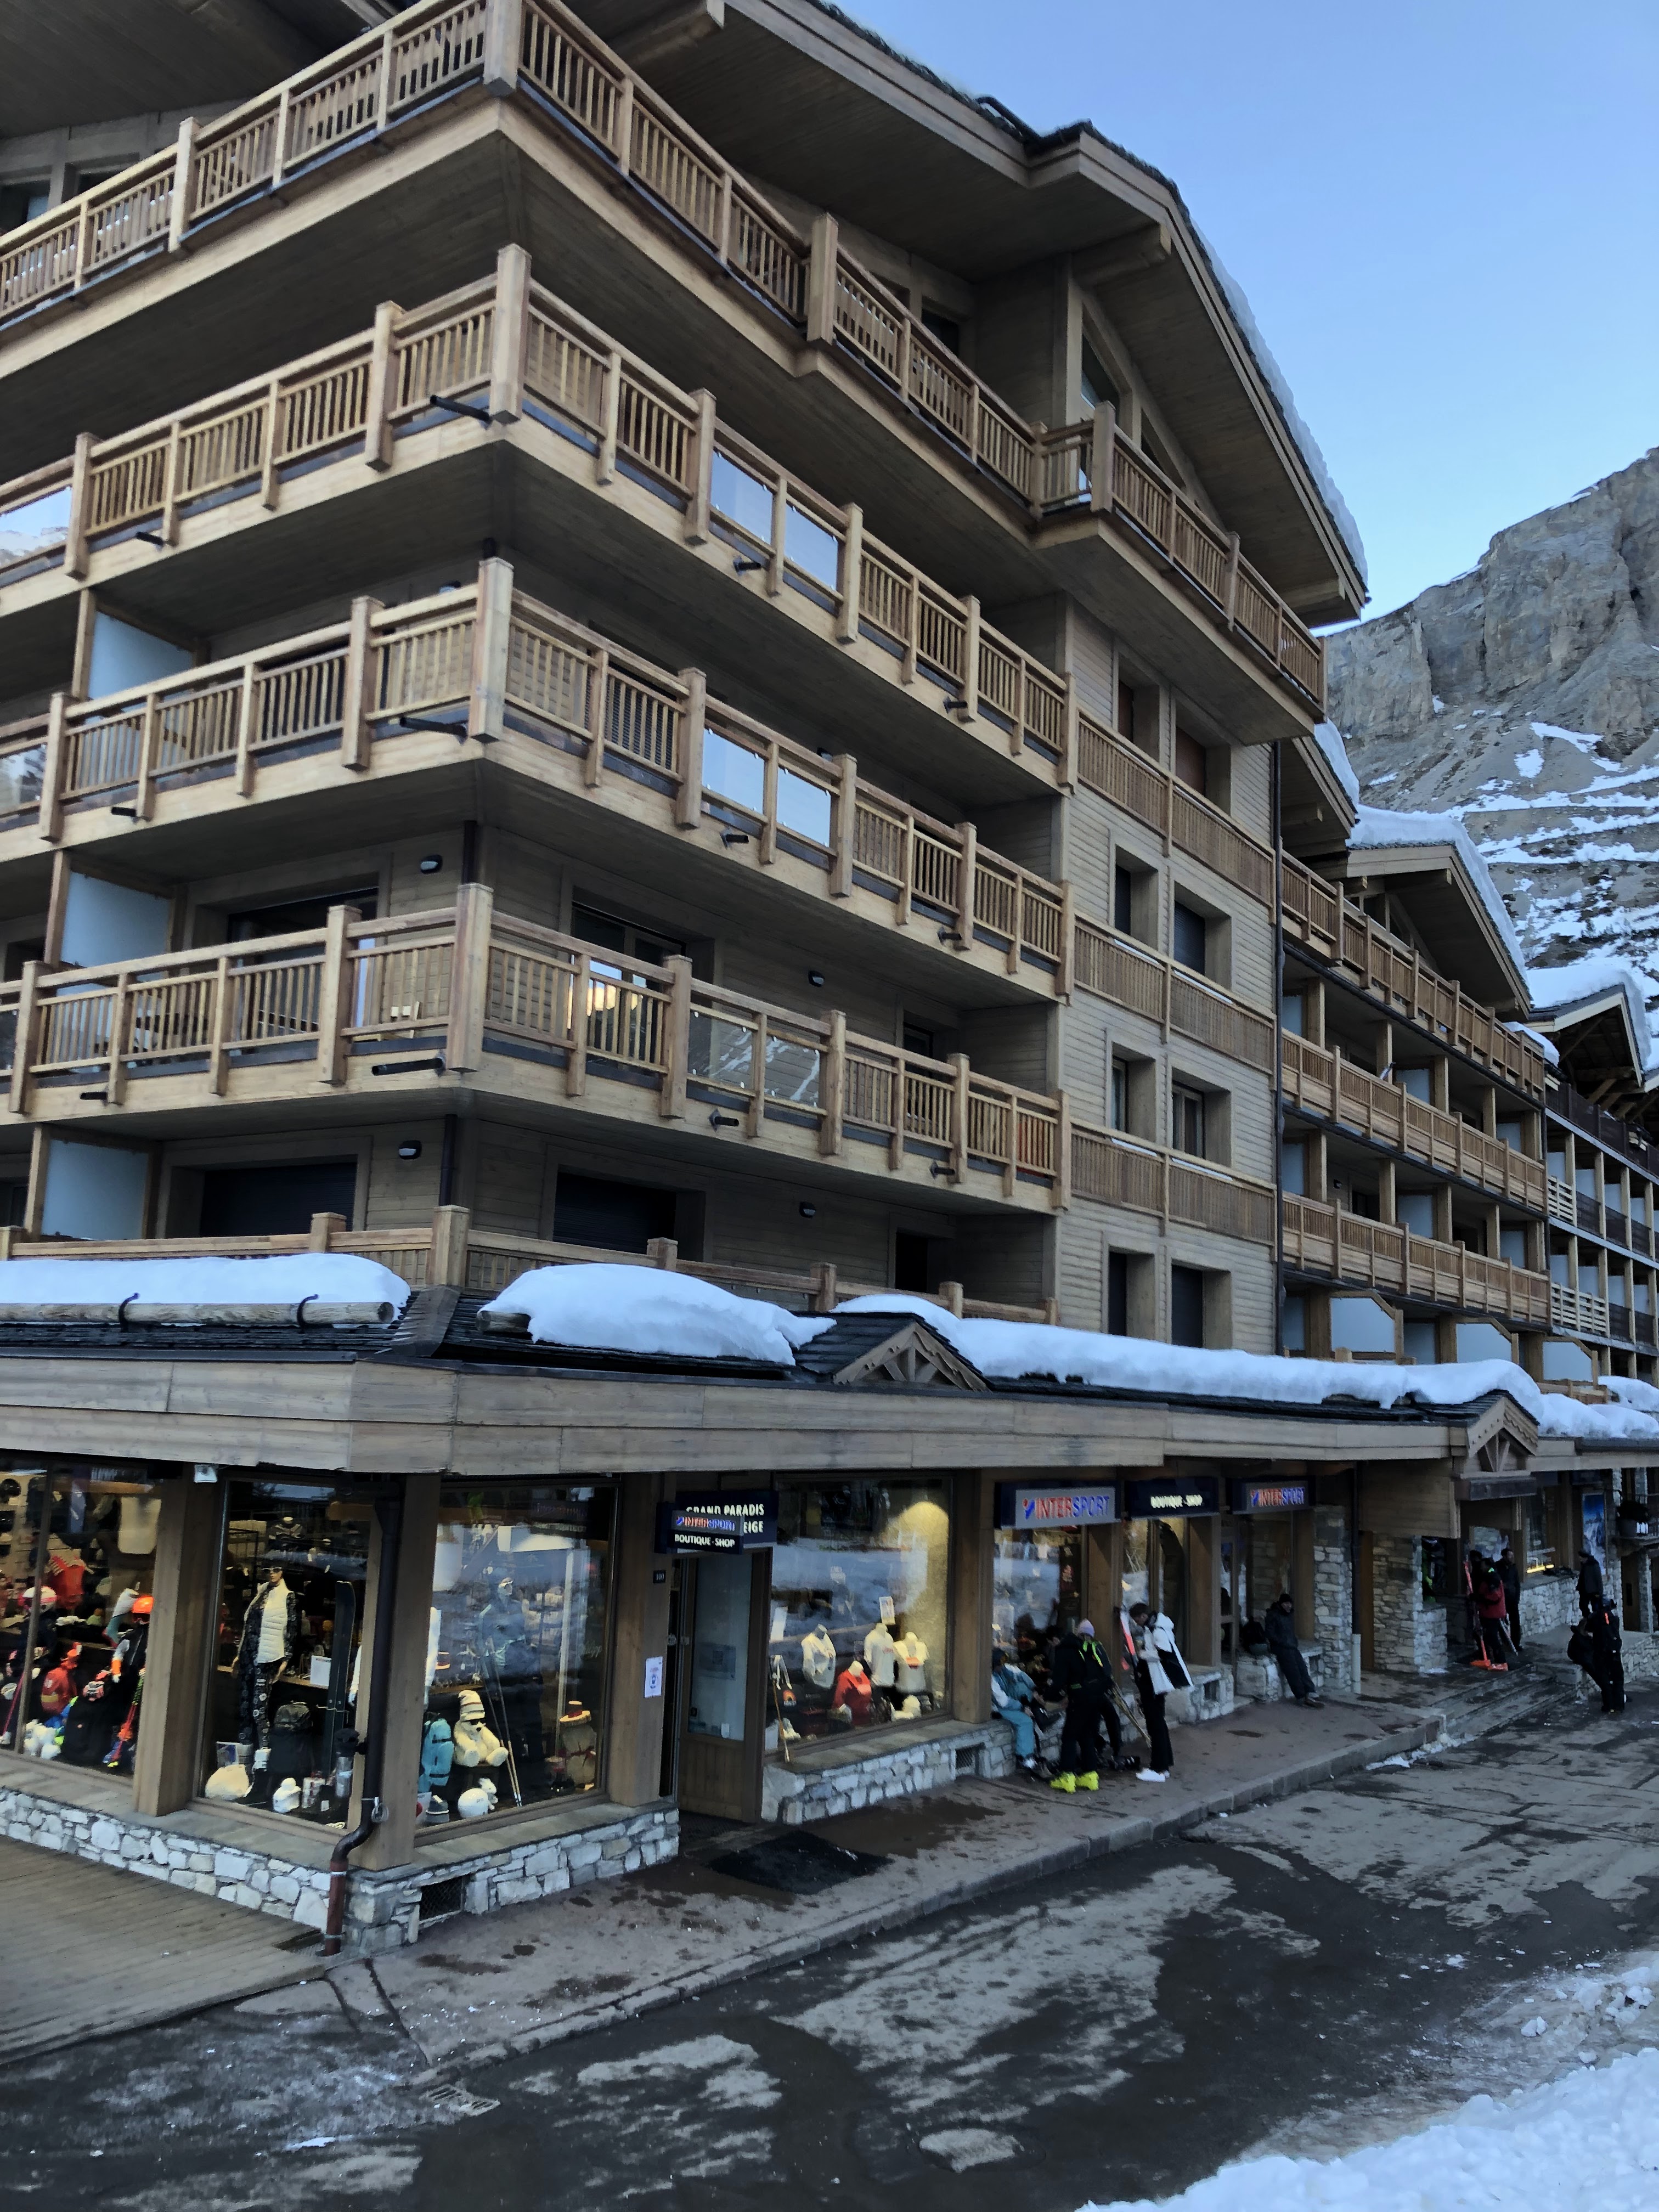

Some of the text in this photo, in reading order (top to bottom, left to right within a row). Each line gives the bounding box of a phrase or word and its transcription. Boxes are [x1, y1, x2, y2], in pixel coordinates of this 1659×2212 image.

[1258, 1486, 1305, 1507] INTERSPORT
[724, 1503, 764, 1516] PARADIS
[1035, 1494, 1110, 1519] INTERSPORT
[685, 1516, 736, 1531] INTERSPORT
[743, 1520, 764, 1534] EIGE
